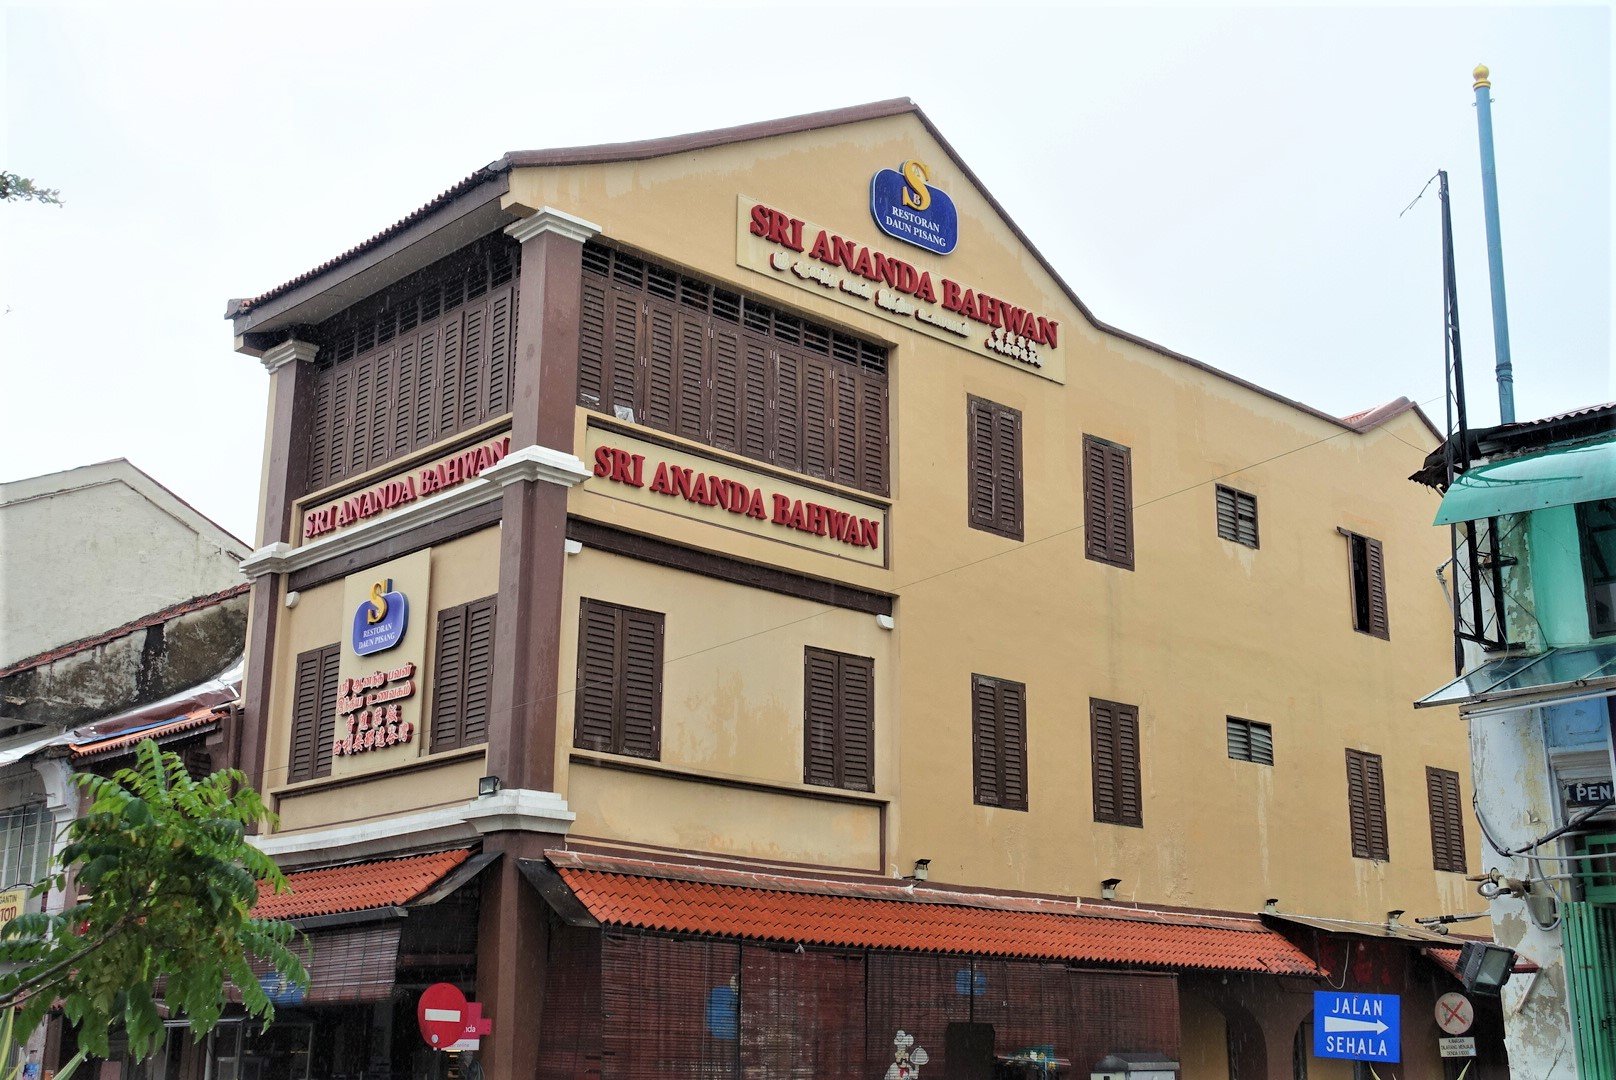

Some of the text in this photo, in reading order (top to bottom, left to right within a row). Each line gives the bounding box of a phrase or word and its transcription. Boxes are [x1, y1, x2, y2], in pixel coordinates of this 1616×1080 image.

[885, 216, 946, 247] DAUN PISANG
[892, 206, 940, 233] RESTORAN
[750, 204, 1059, 350] SRI ANANDA BAHWAN
[304, 437, 511, 539] SRI ANANDA BAHWAN
[593, 445, 880, 550] SRI ANANDA BAHWAN
[363, 623, 393, 639] RESTORAN
[374, 632, 396, 645] PISANG
[1332, 997, 1383, 1016] JALAN
[1325, 1035, 1388, 1056] SEHALA
